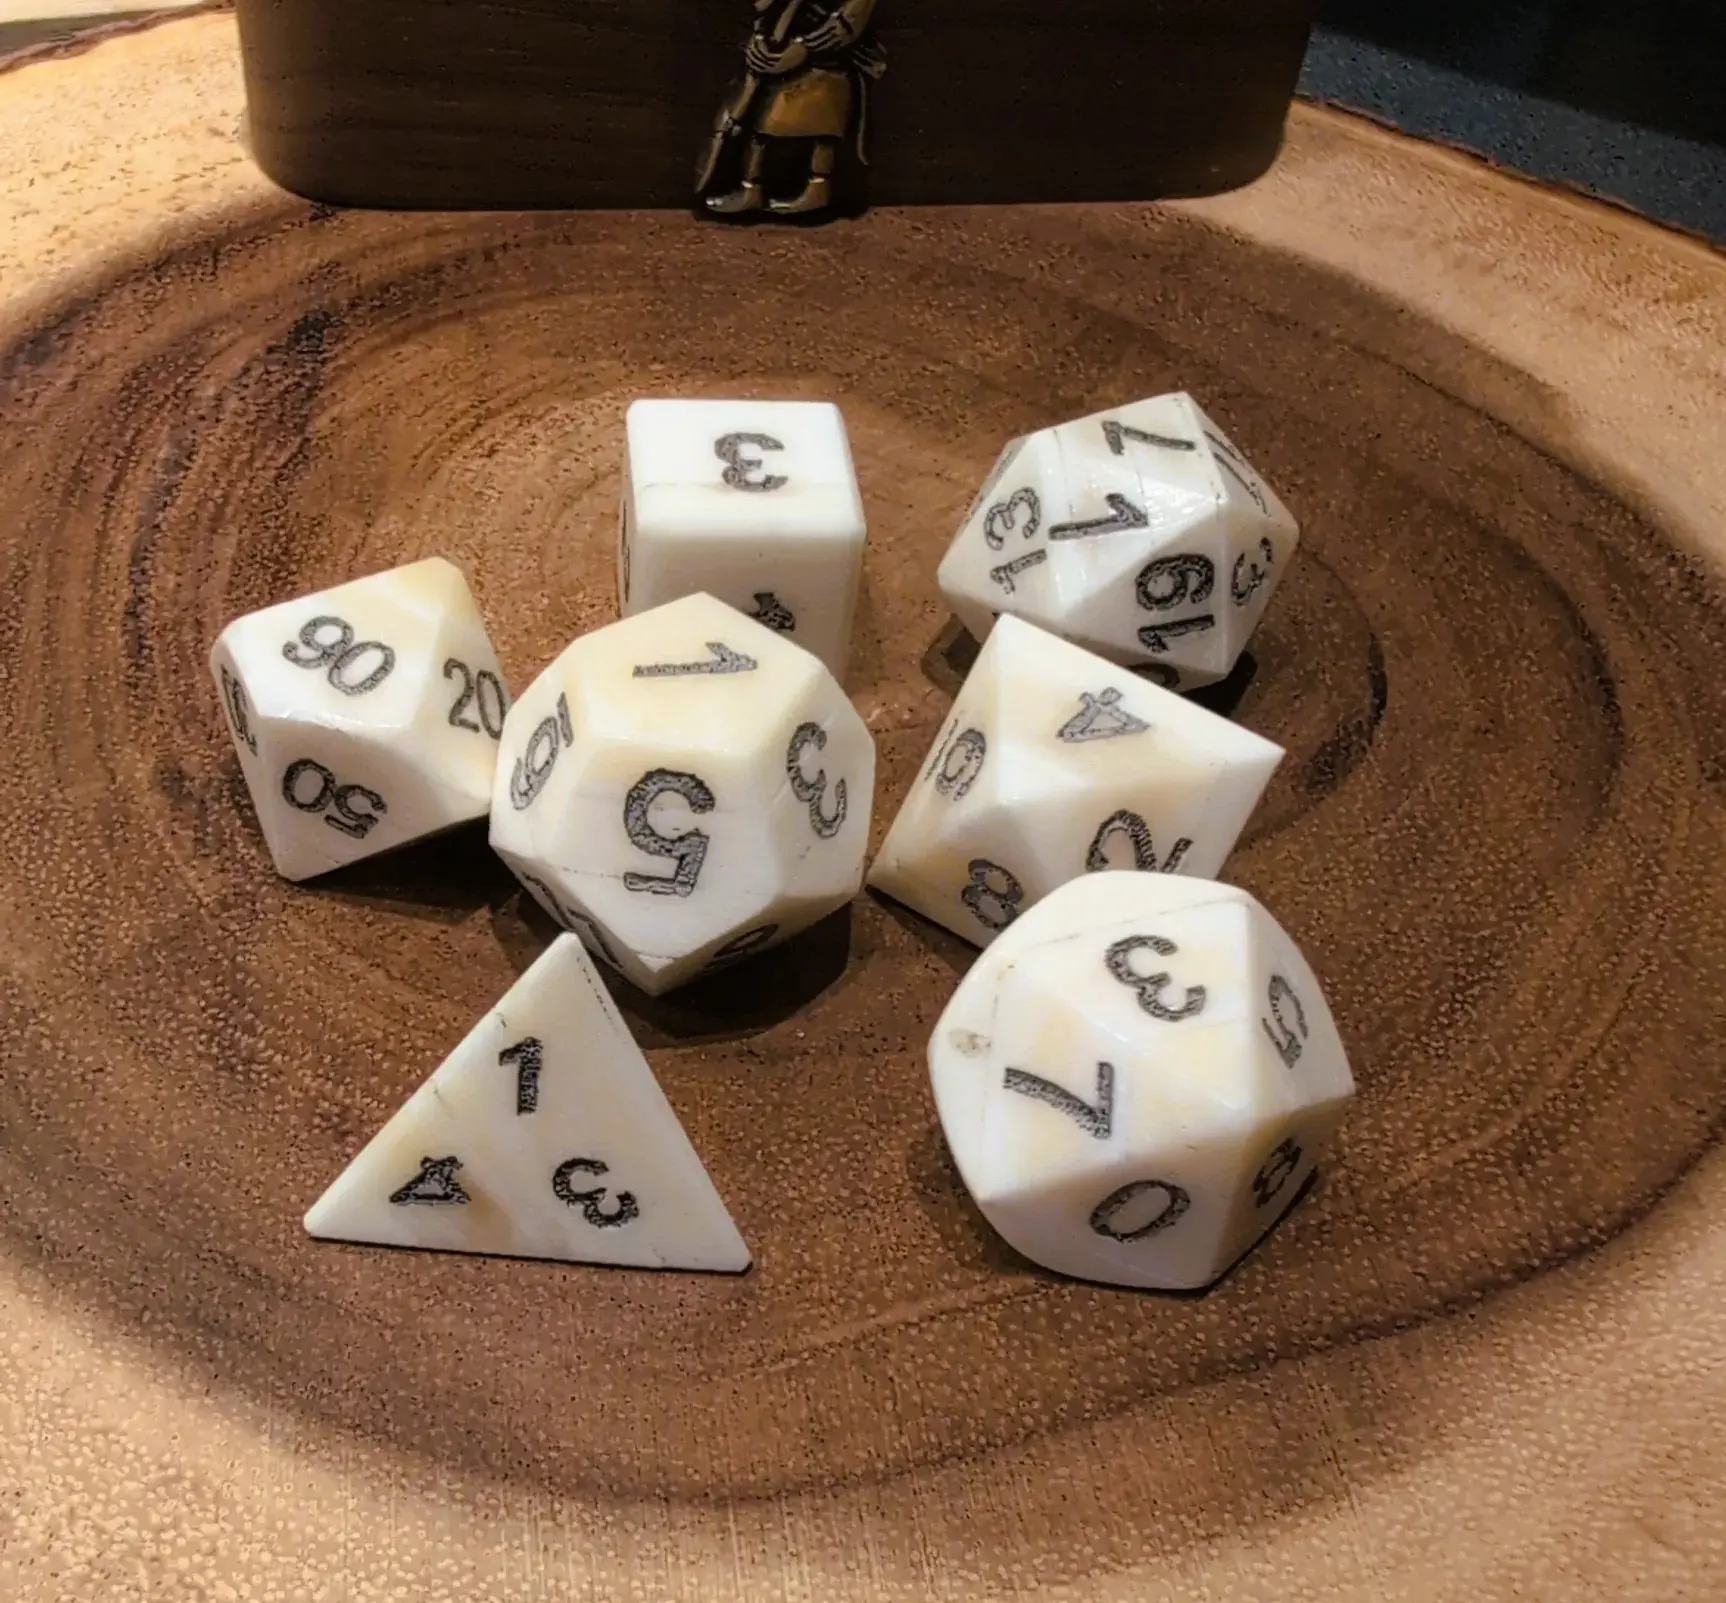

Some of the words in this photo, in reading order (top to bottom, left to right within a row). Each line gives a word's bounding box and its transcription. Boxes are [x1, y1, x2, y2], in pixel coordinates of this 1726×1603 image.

[714, 432, 789, 493] 3
[1102, 420, 1196, 456] 7
[984, 487, 1047, 595] 13
[1049, 493, 1150, 542] 1
[1135, 553, 1216, 652] 19
[282, 615, 396, 696] 90
[632, 642, 758, 678] 1
[443, 658, 507, 741] 20
[1056, 686, 1153, 743] 4
[282, 758, 388, 840] 50
[786, 721, 848, 839] 3
[623, 767, 716, 897] 5
[960, 858, 1024, 930] 8
[1104, 934, 1207, 1023] 3
[1262, 973, 1308, 1070] 5
[498, 1036, 543, 1116] 1
[1002, 1061, 1115, 1141] 7
[389, 1155, 472, 1207] 4
[551, 1157, 641, 1229] 3
[1089, 1179, 1191, 1243] 0
